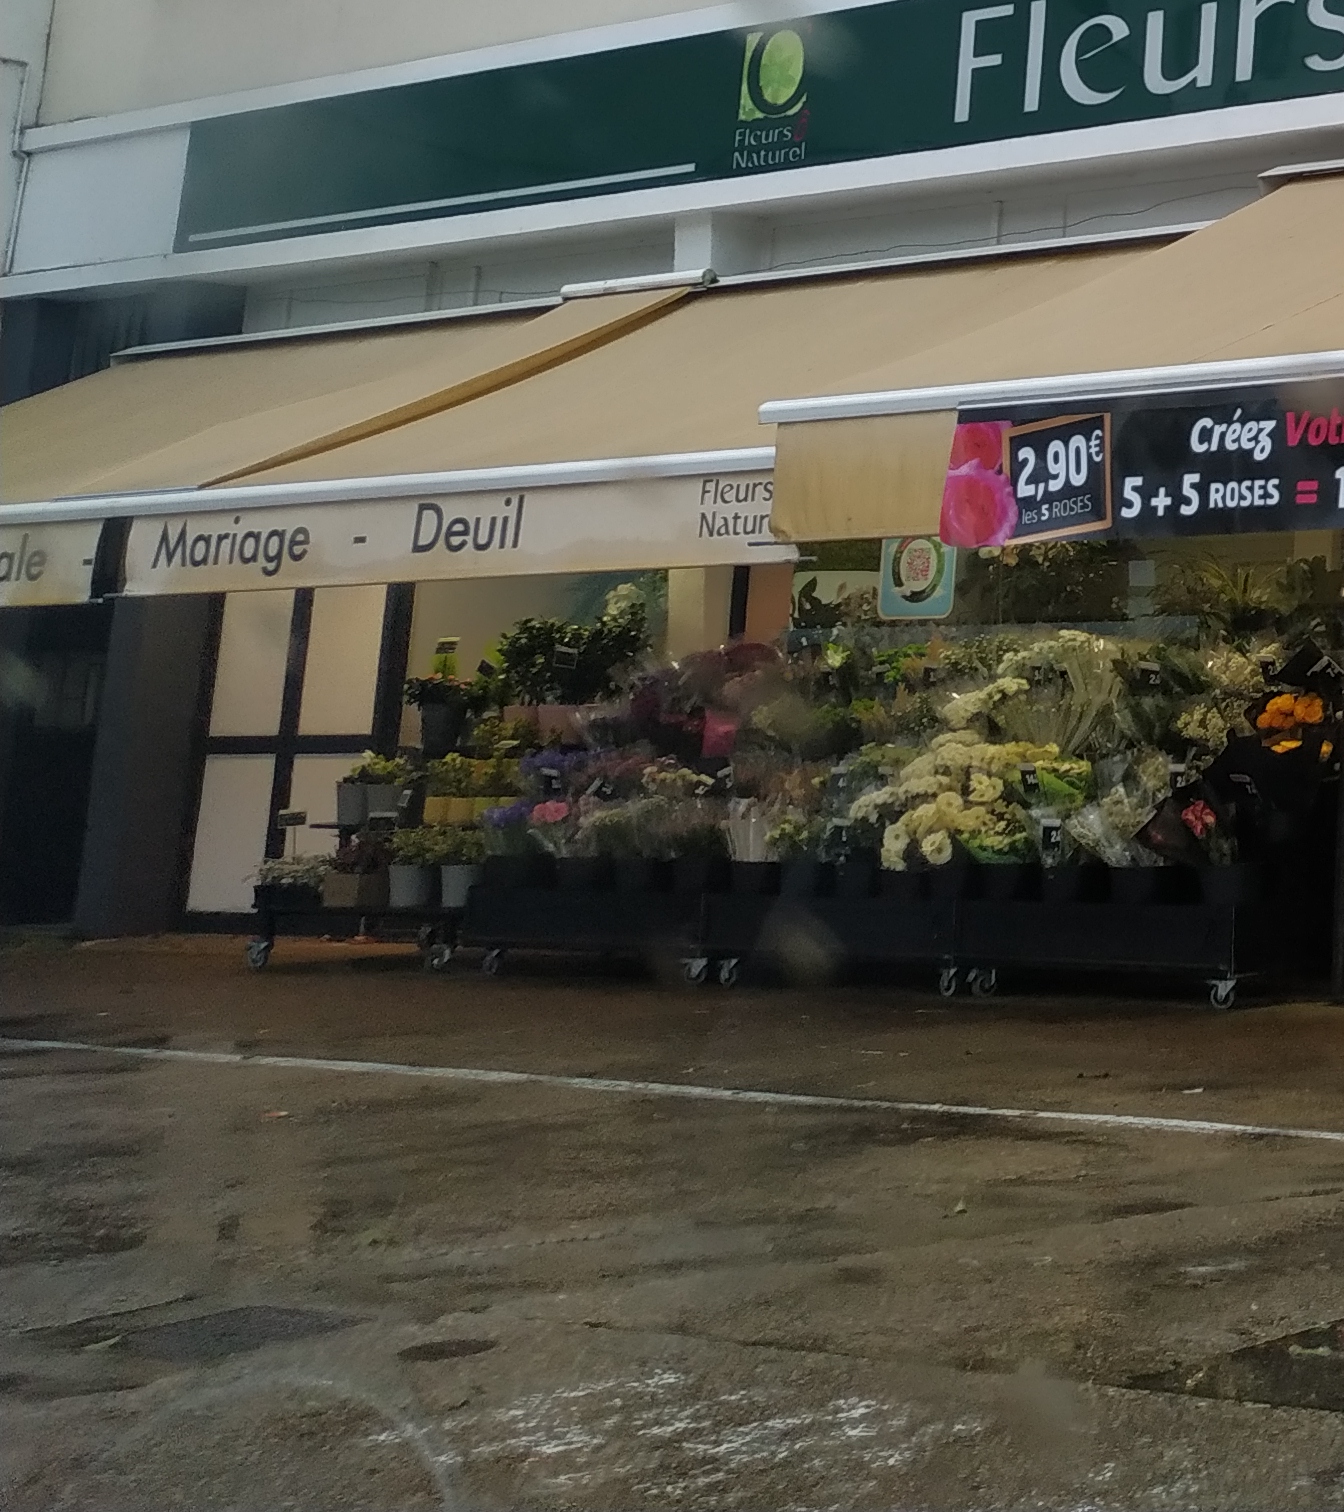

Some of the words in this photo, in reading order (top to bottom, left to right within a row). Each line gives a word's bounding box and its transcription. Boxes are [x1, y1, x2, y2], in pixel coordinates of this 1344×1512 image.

[732, 141, 806, 170] Naturel
[734, 126, 792, 148] Fleurs
[1190, 407, 1277, 461] Créez
[1017, 429, 1104, 502] 2,90€
[699, 478, 774, 506] Fleurs
[1021, 508, 1038, 525] les
[1040, 503, 1050, 521] 5
[1052, 494, 1092, 518] ROSES
[1120, 476, 1144, 518] 5
[1179, 472, 1201, 516] 5
[1208, 478, 1280, 509] ROSES
[151, 519, 311, 576] Mariage
[411, 494, 526, 555] Deuil
